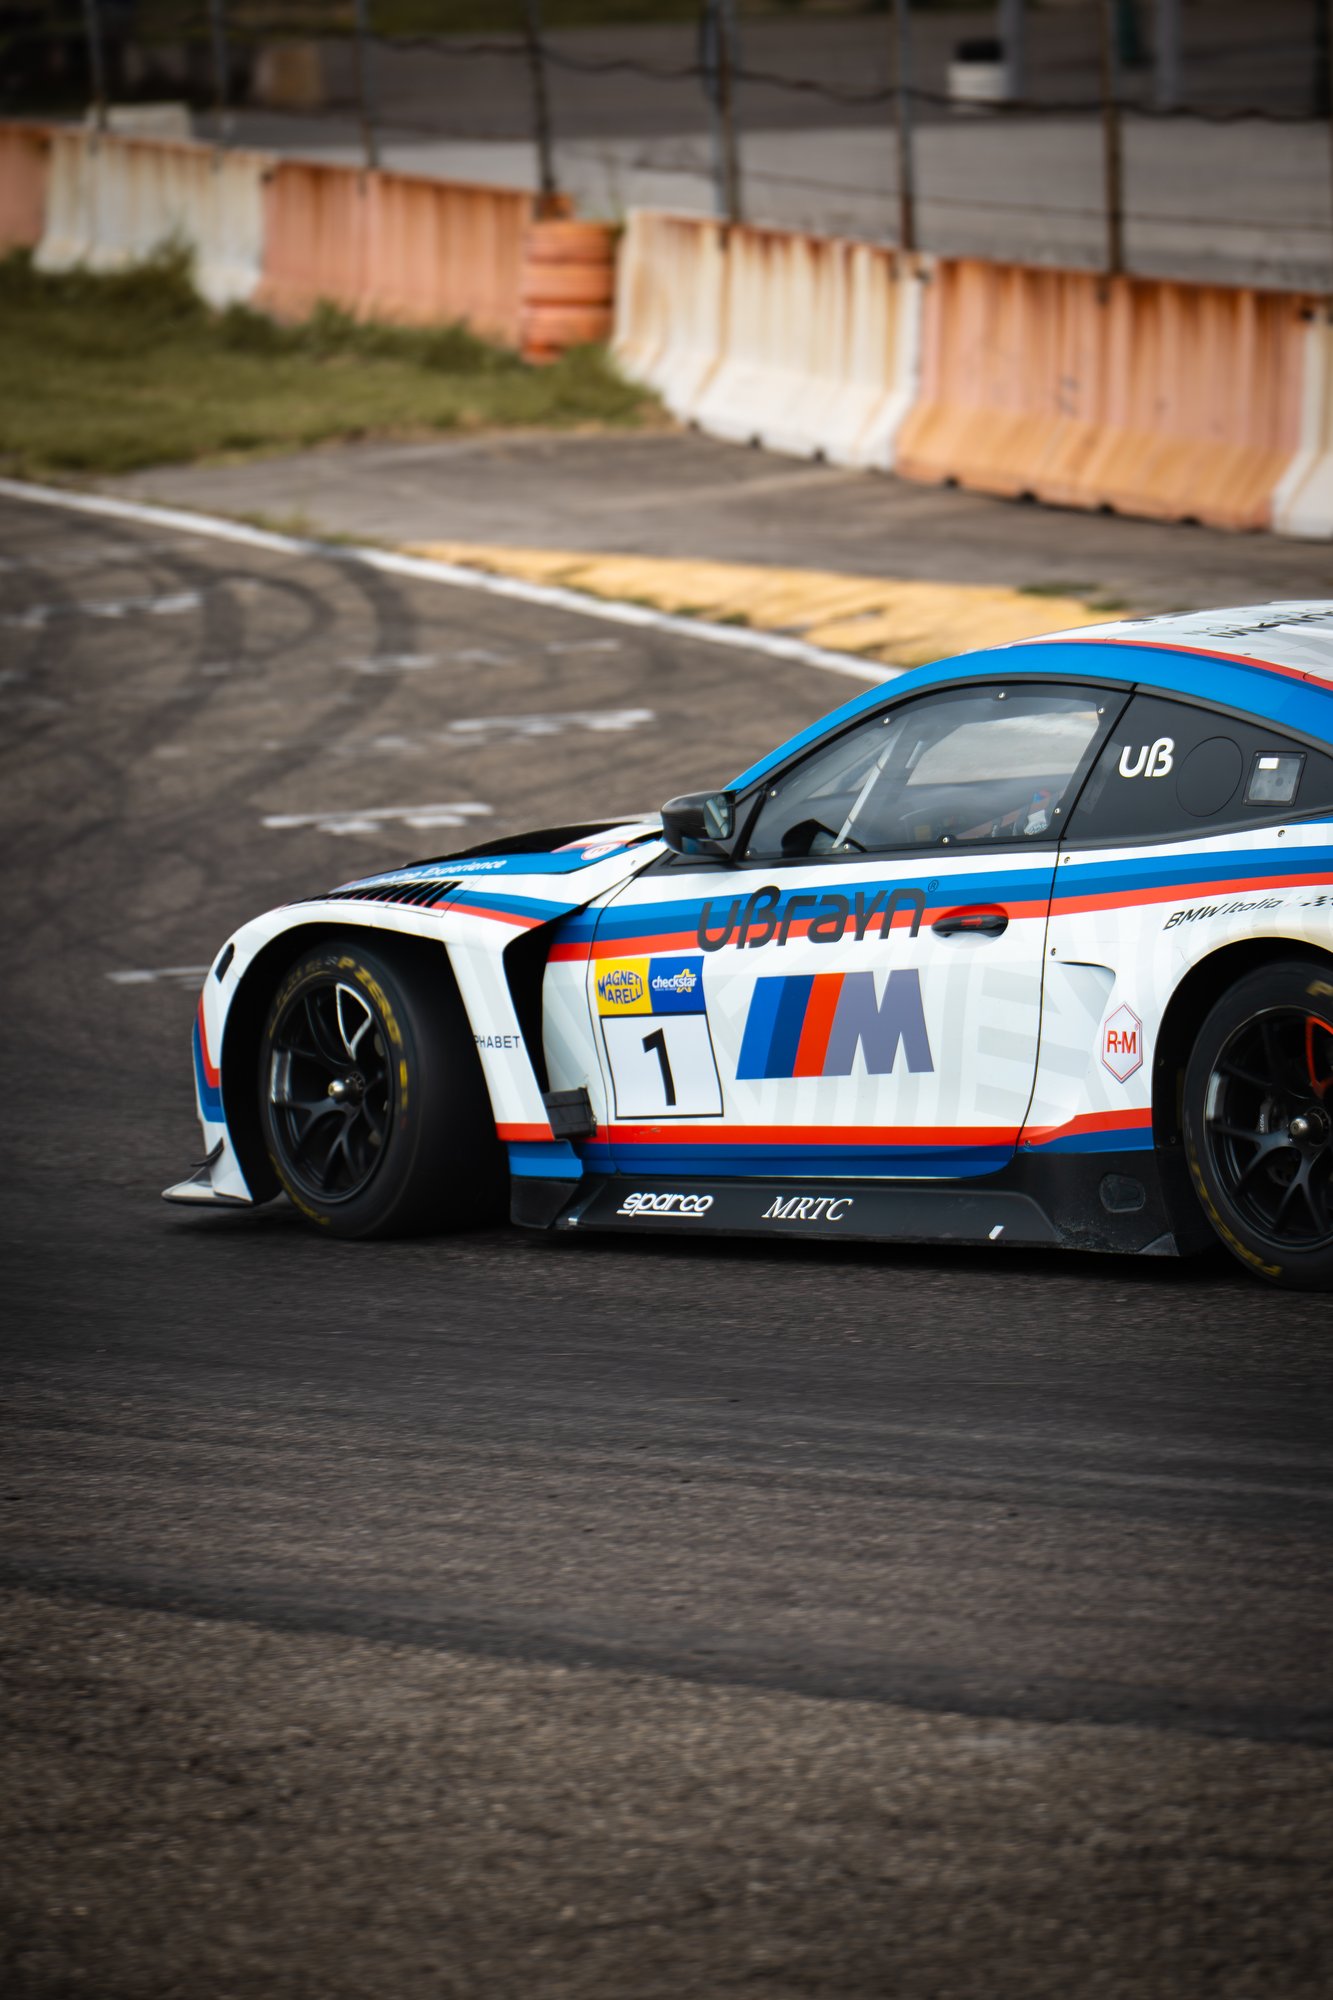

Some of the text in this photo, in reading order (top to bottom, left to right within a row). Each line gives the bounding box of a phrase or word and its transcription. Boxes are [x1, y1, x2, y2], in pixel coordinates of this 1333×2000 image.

[421, 860, 507, 877] Experience
[1163, 903, 1226, 931] BMW
[1221, 898, 1284, 916] Italia
[652, 974, 697, 989] checkstar
[1106, 1030, 1137, 1054] R-M
[642, 1028, 677, 1107] 1
[617, 1192, 715, 1217] sparco
[761, 1196, 853, 1221] MRTC
